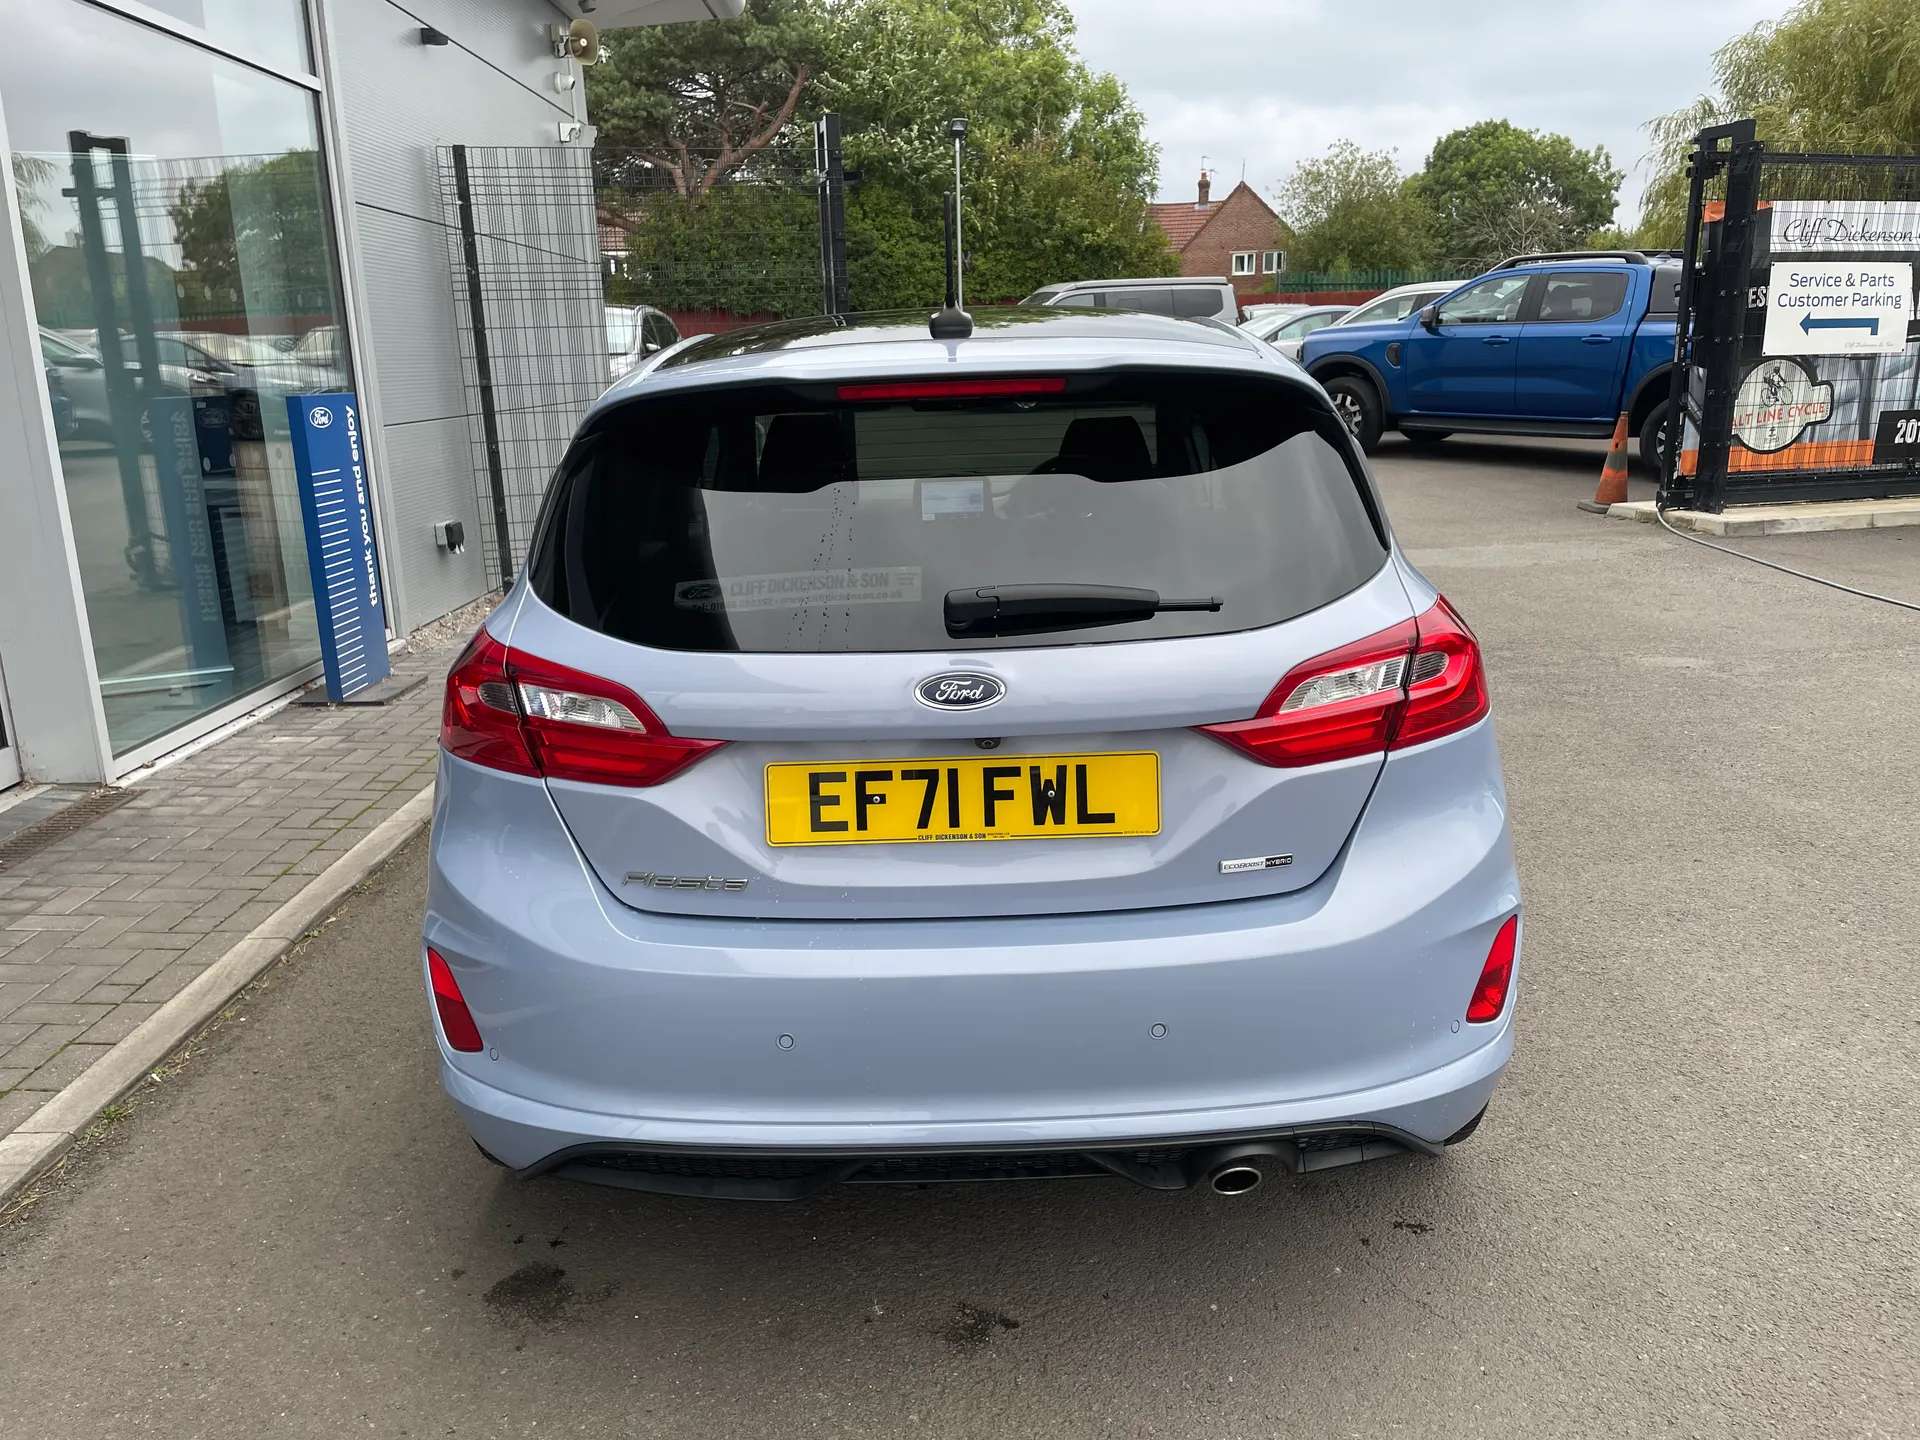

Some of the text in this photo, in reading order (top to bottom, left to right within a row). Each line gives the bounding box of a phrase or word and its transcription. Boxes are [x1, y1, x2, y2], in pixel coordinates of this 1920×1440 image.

[1783, 218, 1913, 247] Cliff Dickenson
[1789, 273, 1895, 288] Service & Parts
[1777, 292, 1902, 309] Customer Parking
[314, 411, 329, 425] Ford
[1732, 411, 1753, 427] ALT
[1756, 409, 1783, 424] LINE
[1787, 402, 1826, 418] CYCLE
[345, 405, 378, 607] thank you and enjoy
[767, 574, 846, 595] DICKENSON
[861, 571, 889, 588] SON
[935, 680, 984, 701] Ford
[808, 763, 1116, 833] EF71 FWL
[935, 833, 968, 841] DICKENSON
[975, 832, 986, 840] SON
[1265, 857, 1292, 867] HYBRID
[622, 871, 750, 891] Fiesta
